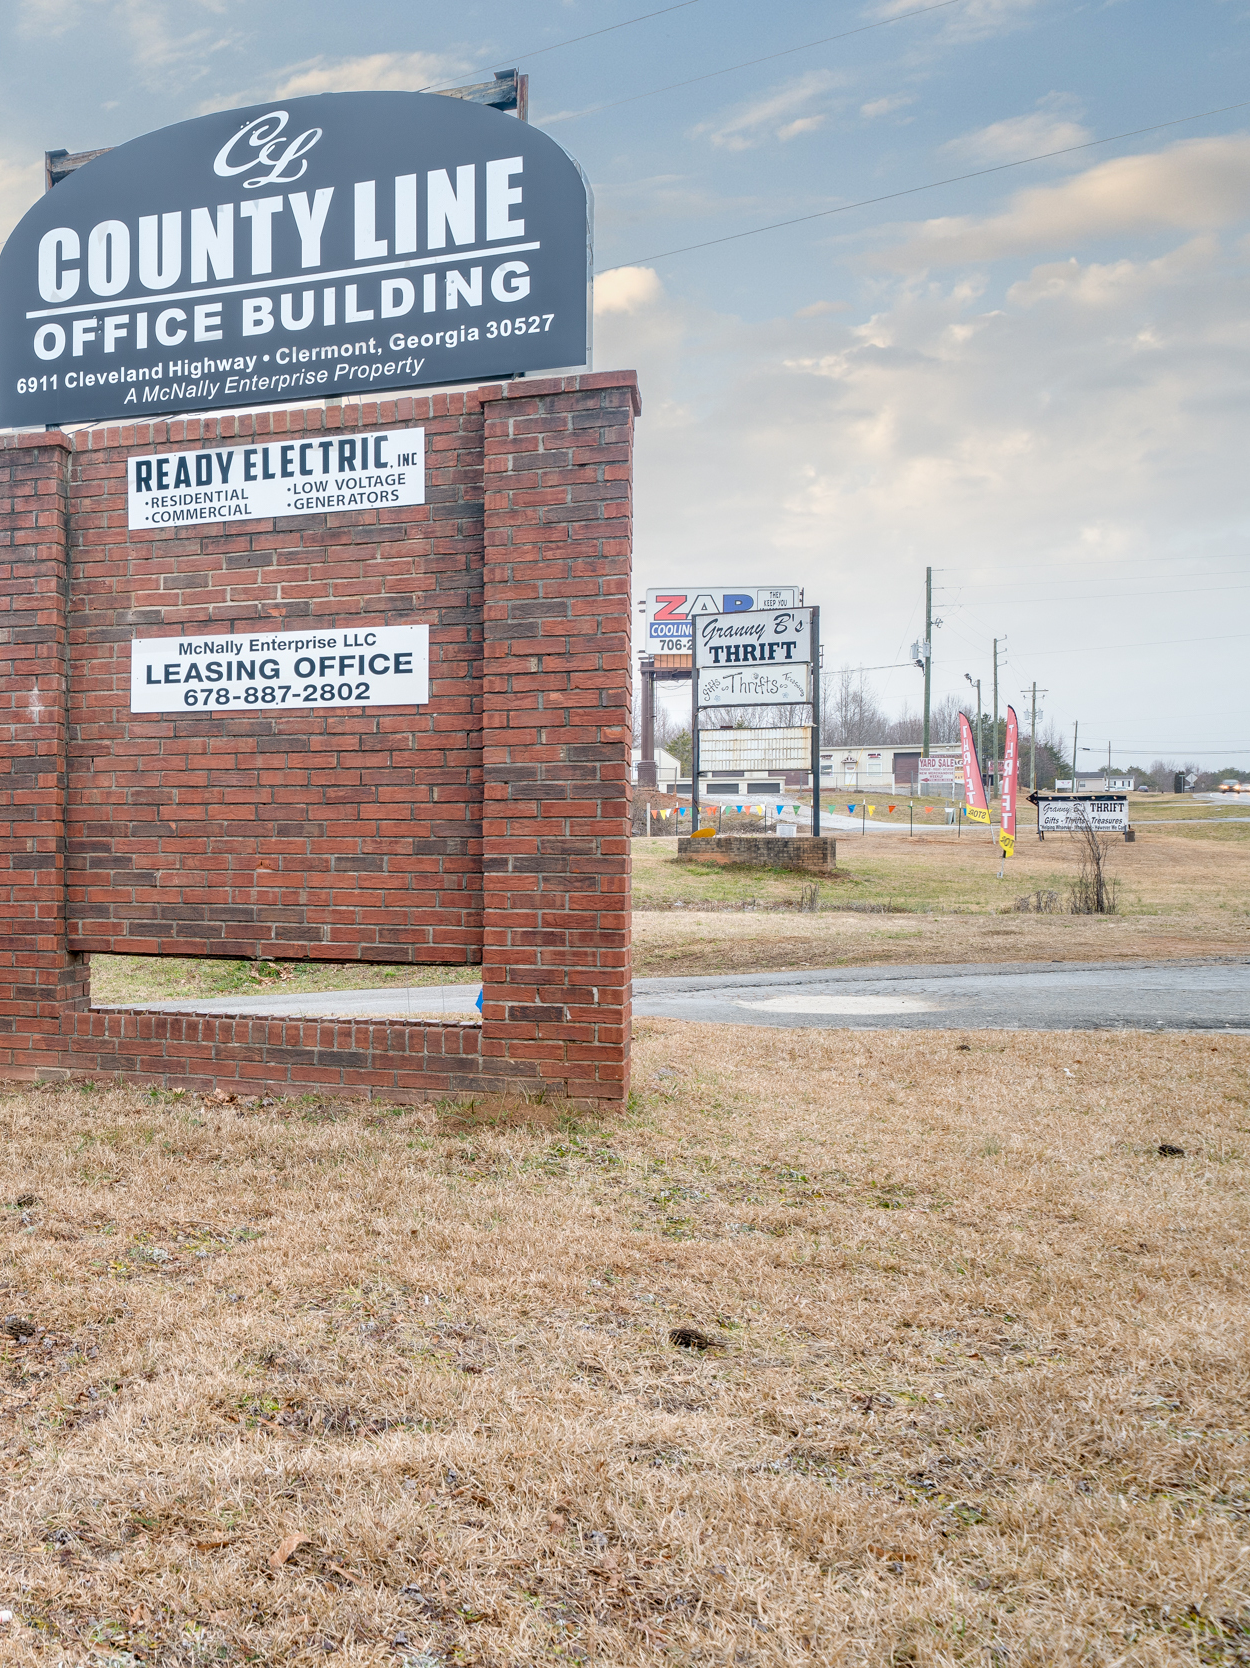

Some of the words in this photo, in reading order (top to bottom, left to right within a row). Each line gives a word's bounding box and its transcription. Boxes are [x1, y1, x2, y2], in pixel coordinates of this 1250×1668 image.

[38, 187, 334, 303] COUNTY
[354, 156, 526, 261] LINE
[33, 302, 223, 361] OFFICE
[242, 261, 531, 337] BUILDING
[16, 374, 58, 394] 6911
[64, 363, 163, 388] Cleveland
[169, 354, 258, 379] Highway
[275, 337, 383, 364] Clermont,
[389, 325, 480, 350] Georgia
[485, 313, 555, 339] 30527
[124, 388, 138, 405] A
[142, 379, 220, 403] McNally
[225, 369, 328, 394] Enterprise
[334, 356, 426, 382] Property
[135, 451, 235, 493] READY
[397, 452, 418, 467] INC
[293, 480, 328, 495] LOW
[335, 473, 406, 491] VOLTAGE
[151, 488, 249, 509] RESIDENTIAL
[294, 489, 399, 510] GENERATORS
[151, 503, 252, 523] COMMERCIAL
[654, 594, 754, 621] ZAP
[701, 618, 766, 647] Granny
[773, 613, 804, 635] B's
[178, 640, 244, 656] McNally
[249, 636, 337, 655] Enterprise
[343, 633, 377, 647] LLC
[709, 641, 797, 663] THRIFT
[146, 658, 281, 685] LEASING
[293, 652, 413, 679] OFFICE
[183, 682, 371, 706] 678-887-2802
[723, 672, 779, 695] Thrifts
[920, 759, 936, 767] YARD
[938, 759, 954, 767] SALE
[1043, 803, 1071, 815] Granny
[1090, 803, 1125, 812] THRIFT
[1091, 817, 1123, 825] Treasures
